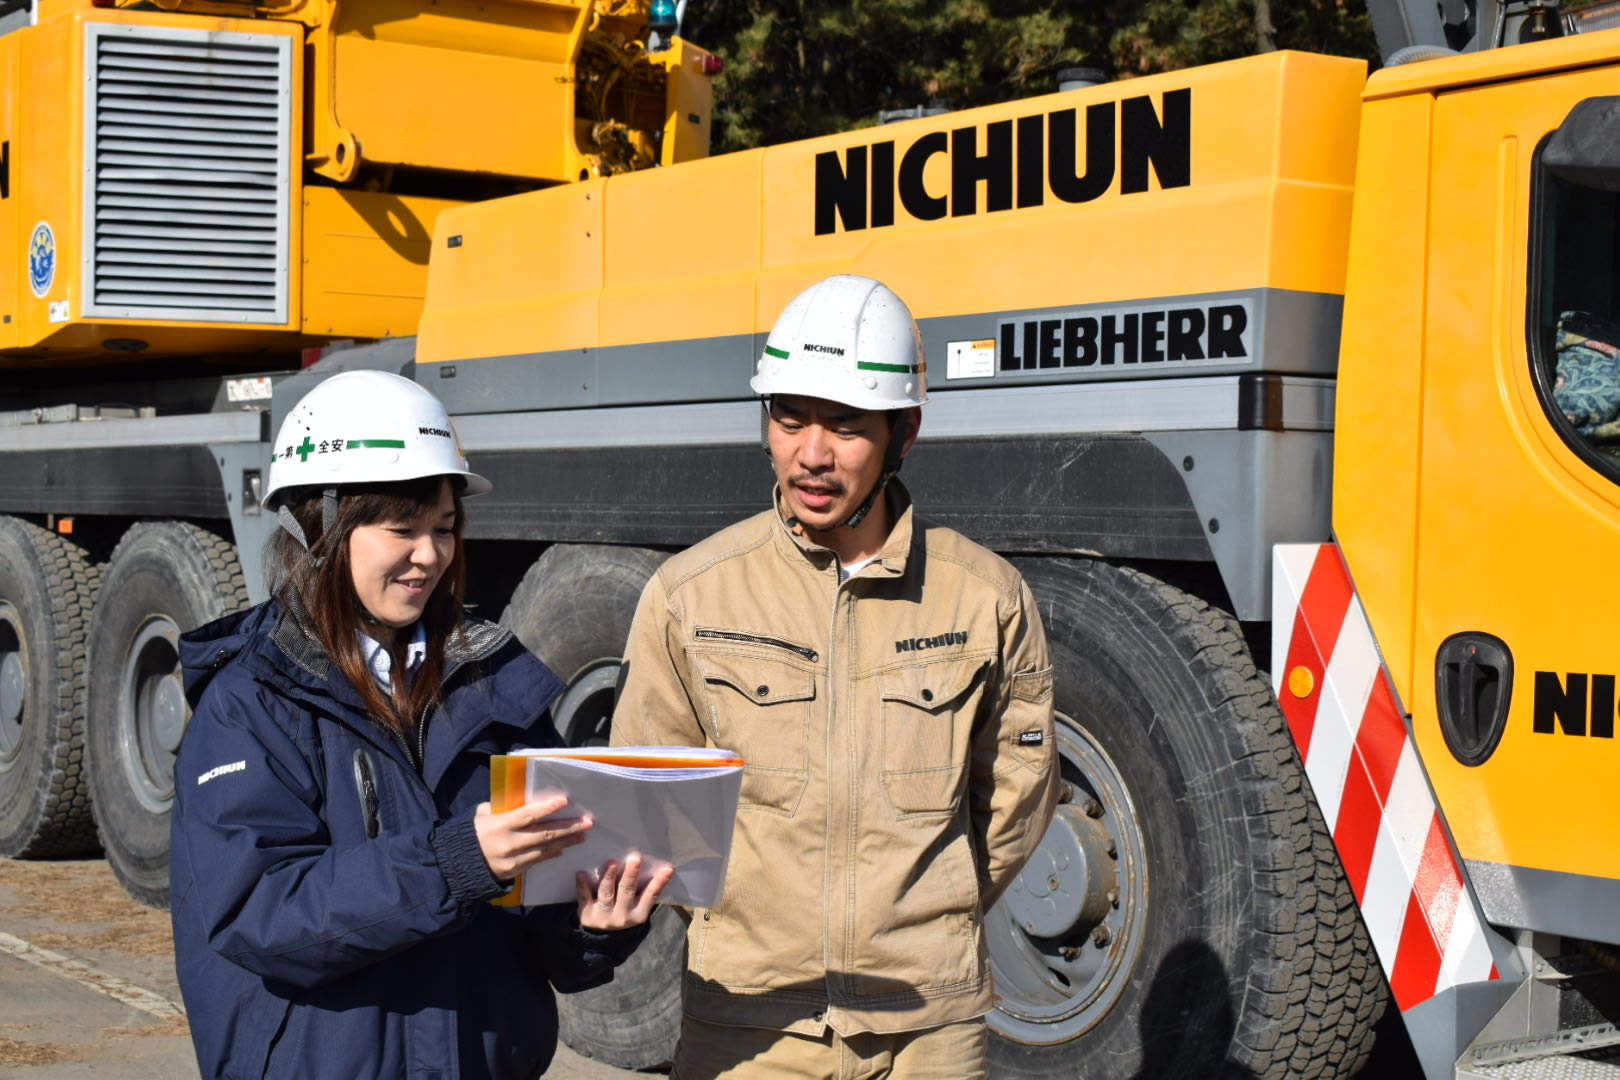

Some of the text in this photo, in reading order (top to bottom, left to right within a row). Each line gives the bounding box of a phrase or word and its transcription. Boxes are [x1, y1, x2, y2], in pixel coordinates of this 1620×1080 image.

[815, 88, 1191, 236] NICHIUN
[804, 343, 845, 356] NICHIUN
[1000, 305, 1248, 371] LIEBHERR
[895, 631, 968, 653] NICHIUN
[1533, 671, 1620, 739] NI
